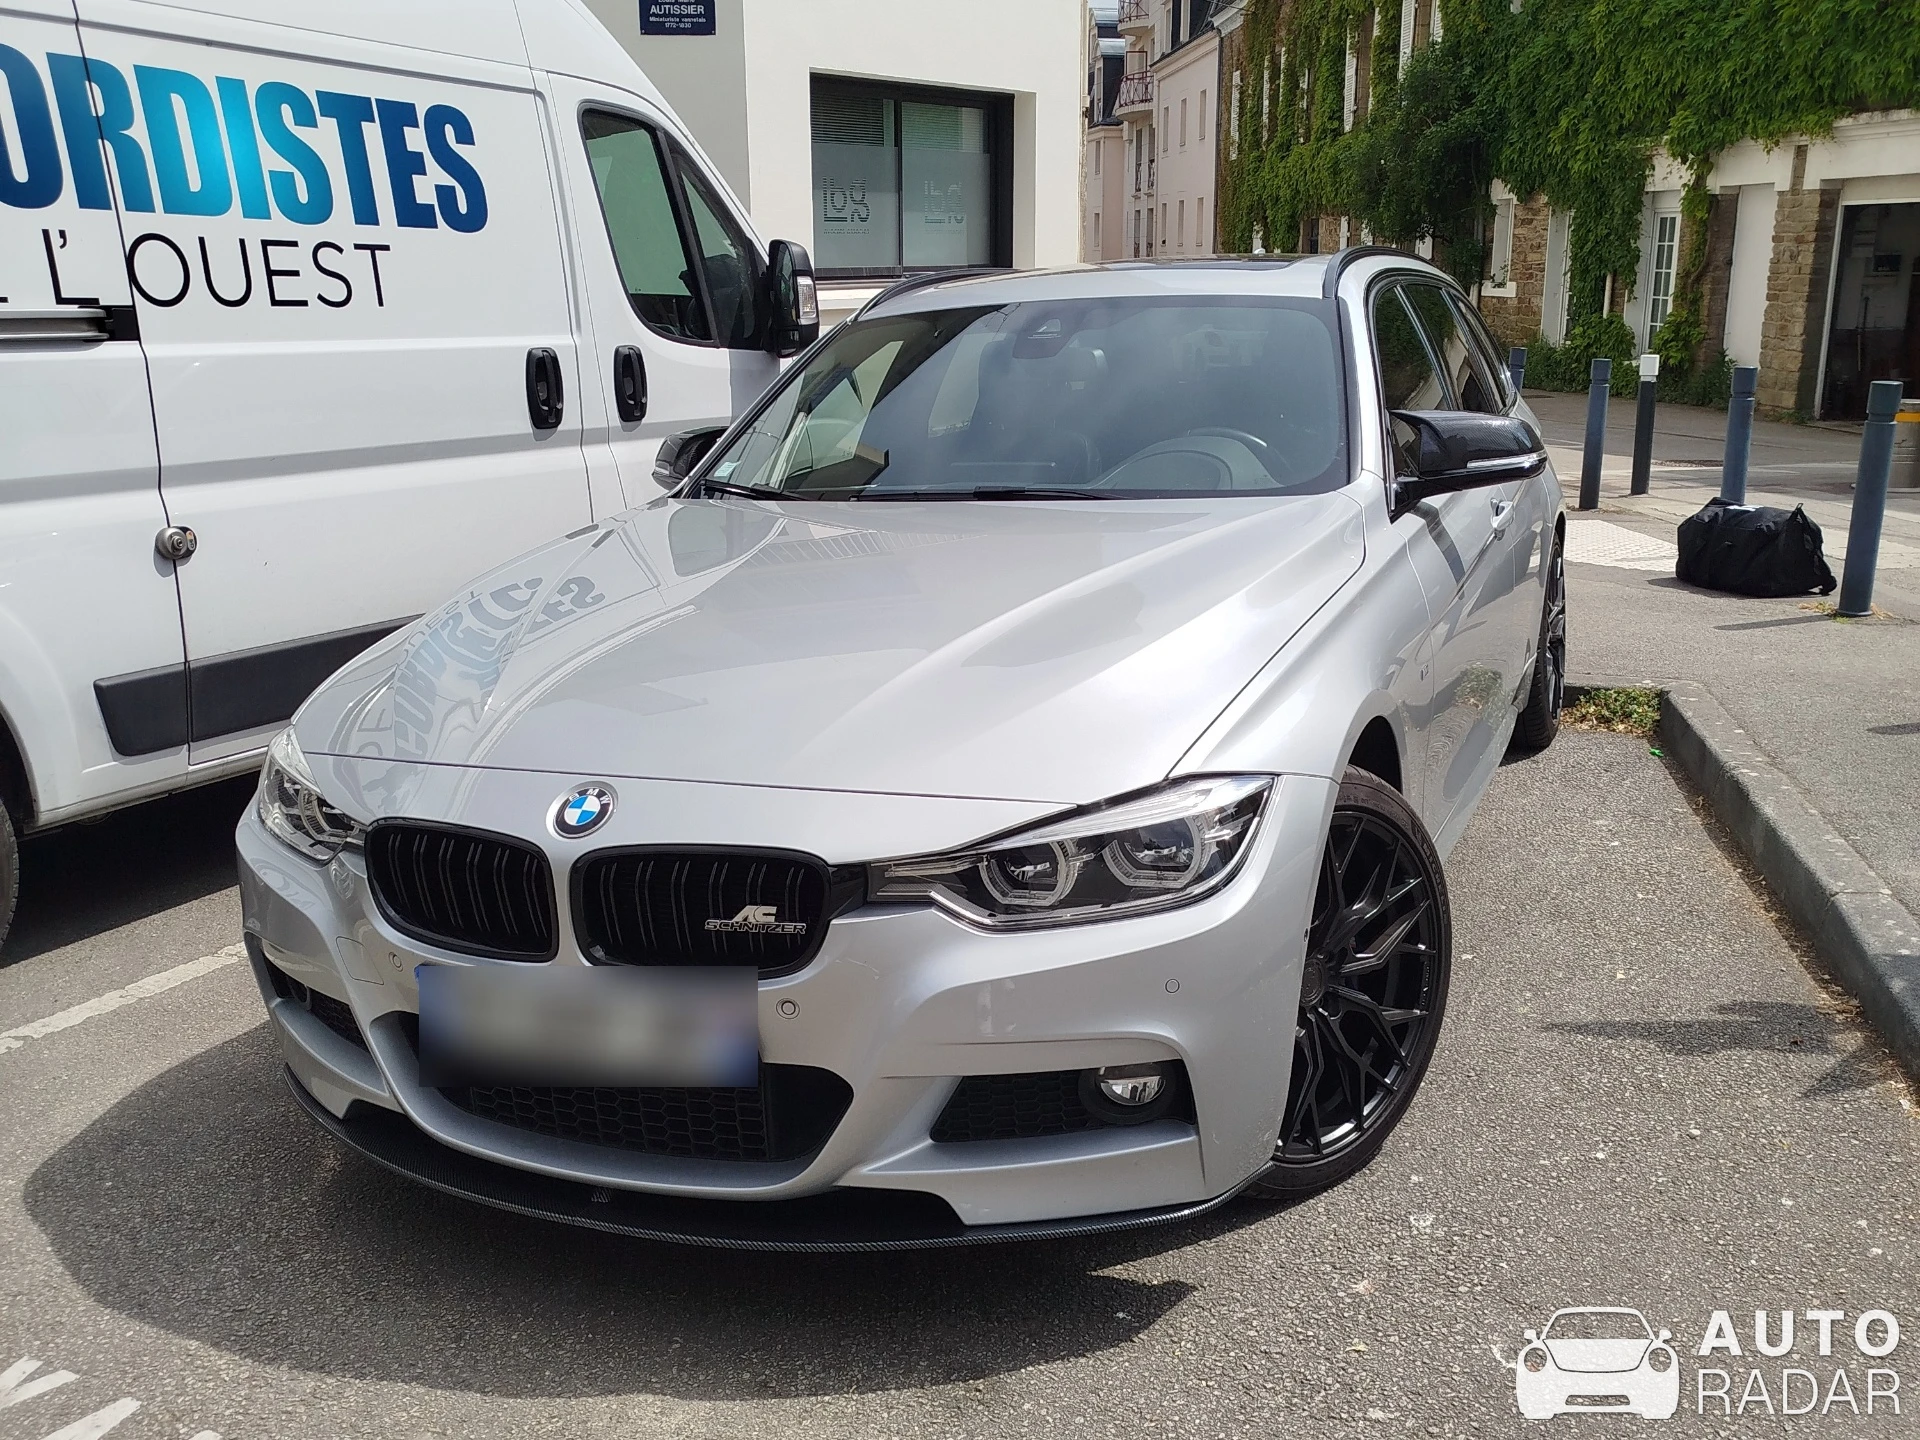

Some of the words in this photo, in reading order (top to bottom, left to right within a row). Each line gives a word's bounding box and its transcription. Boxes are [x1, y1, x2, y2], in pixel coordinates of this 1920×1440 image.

[649, 5, 705, 15] AUTISSIER
[569, 787, 611, 805] BMW
[731, 904, 778, 924] AC
[704, 919, 807, 935] SCHNITZER
